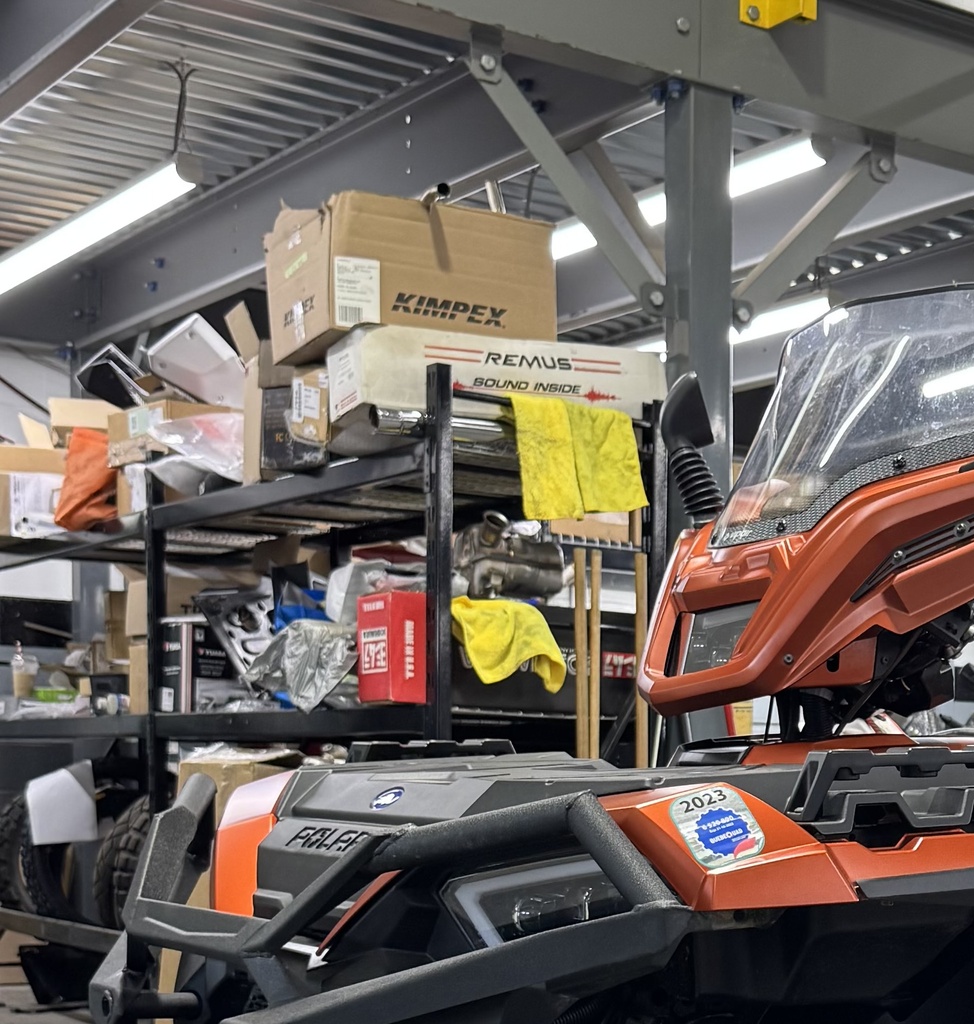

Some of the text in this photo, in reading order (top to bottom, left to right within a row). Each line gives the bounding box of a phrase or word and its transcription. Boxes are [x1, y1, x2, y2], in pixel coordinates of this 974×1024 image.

[283, 294, 316, 328] KIEX
[391, 292, 508, 329] KIMPEX
[484, 351, 573, 371] REMUS
[473, 377, 582, 394] SOUND INSIDE
[680, 789, 728, 814] 2023
